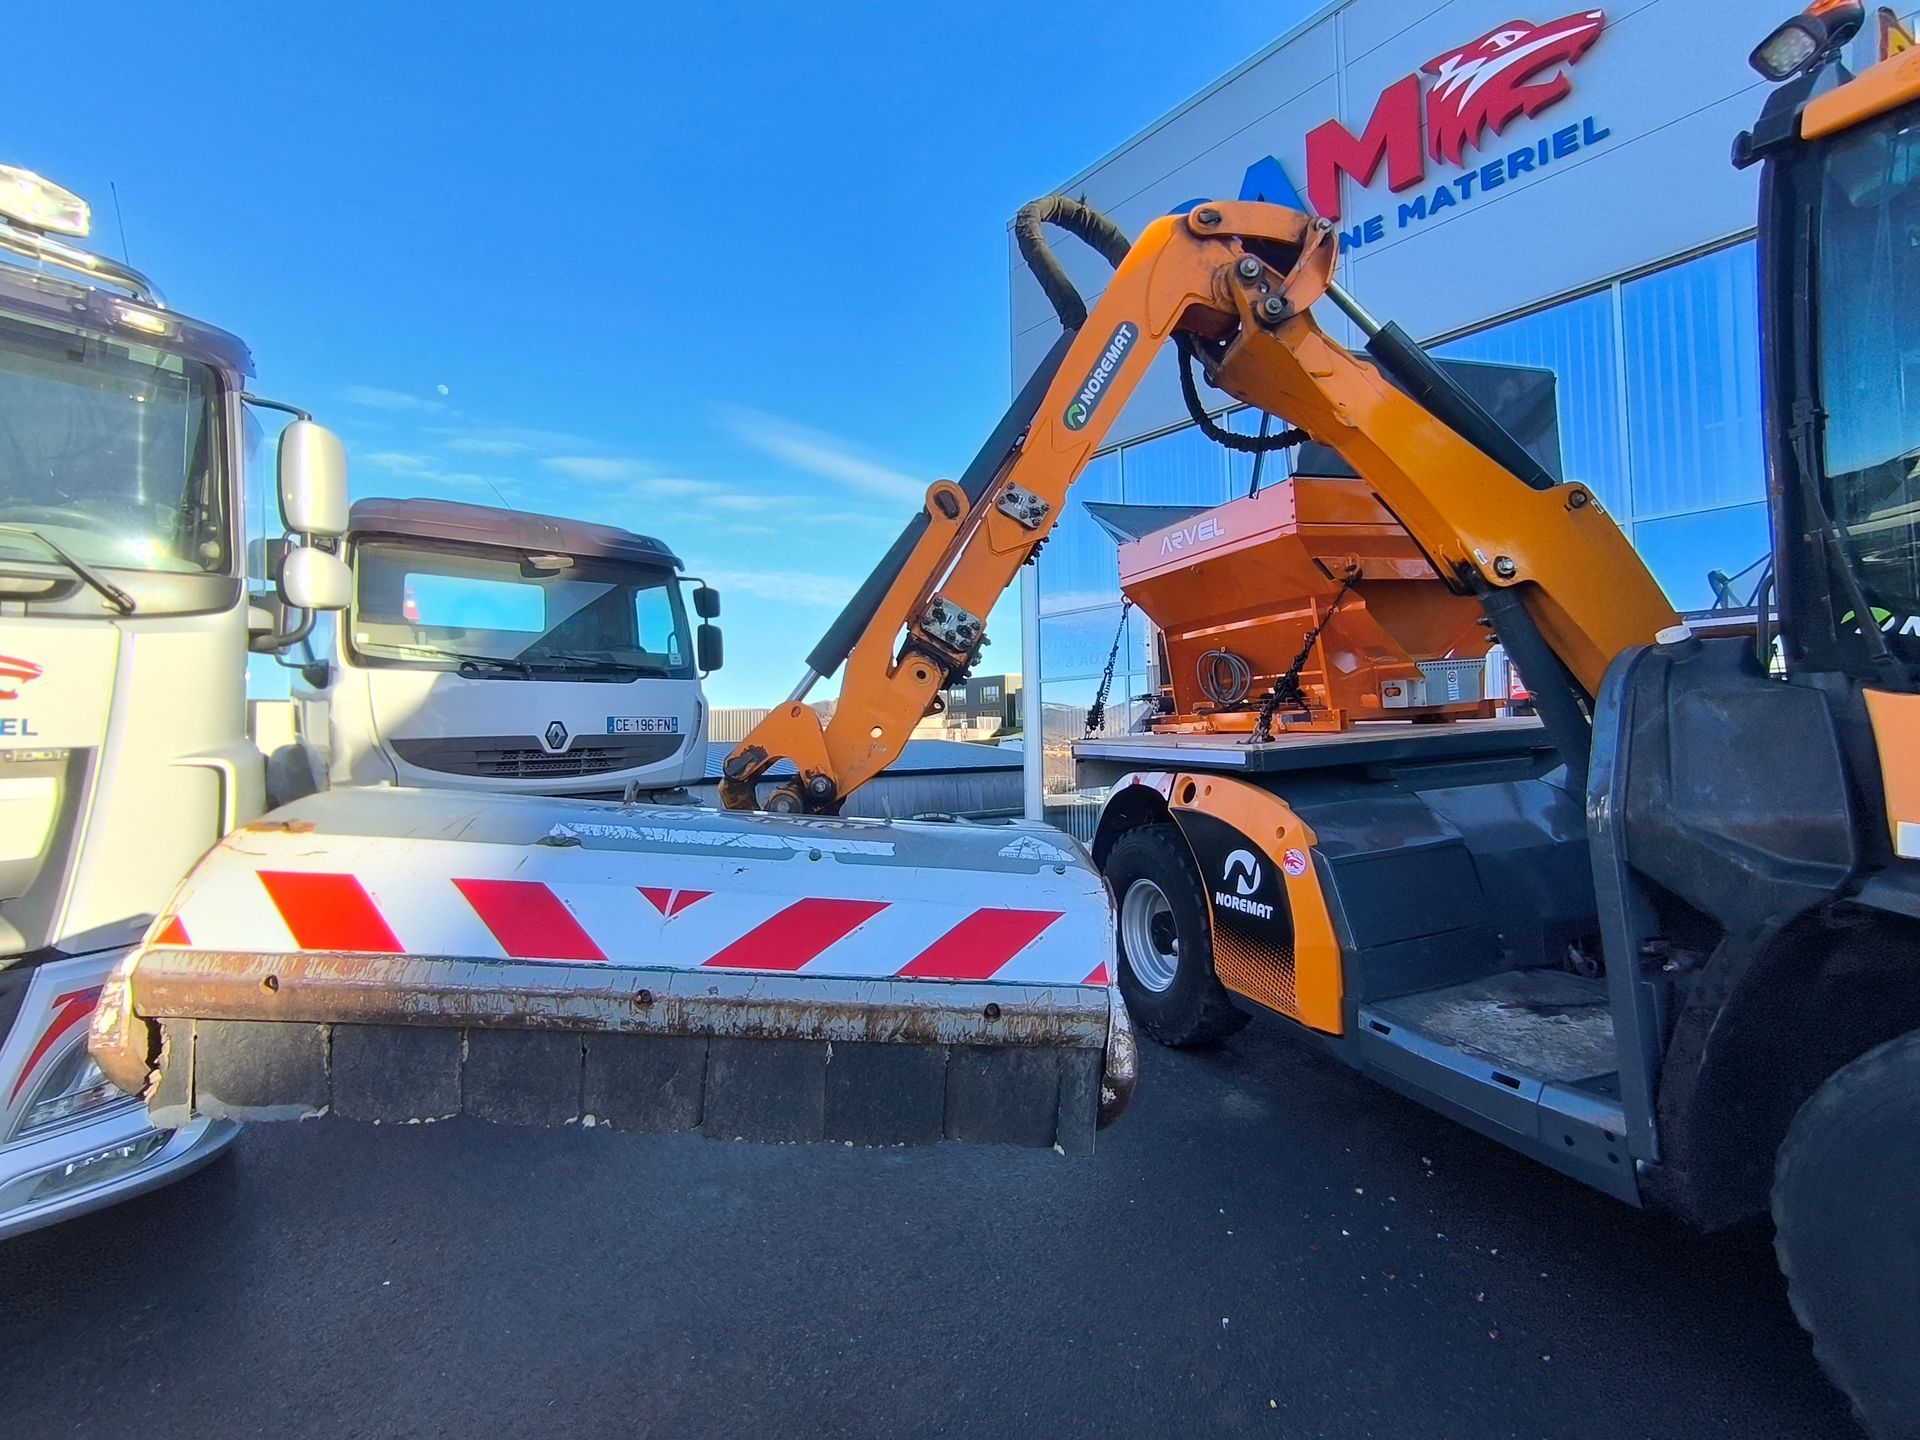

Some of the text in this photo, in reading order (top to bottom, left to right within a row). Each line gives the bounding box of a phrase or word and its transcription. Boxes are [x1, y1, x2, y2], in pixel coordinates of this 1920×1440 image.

[1166, 73, 1425, 222] AM
[1339, 115, 1611, 254] NE MATERIEL
[1080, 324, 1132, 406] NOREMAT
[1160, 517, 1225, 556] ARVEL
[0, 717, 39, 736] EL
[1215, 891, 1274, 920] NOREMAT
